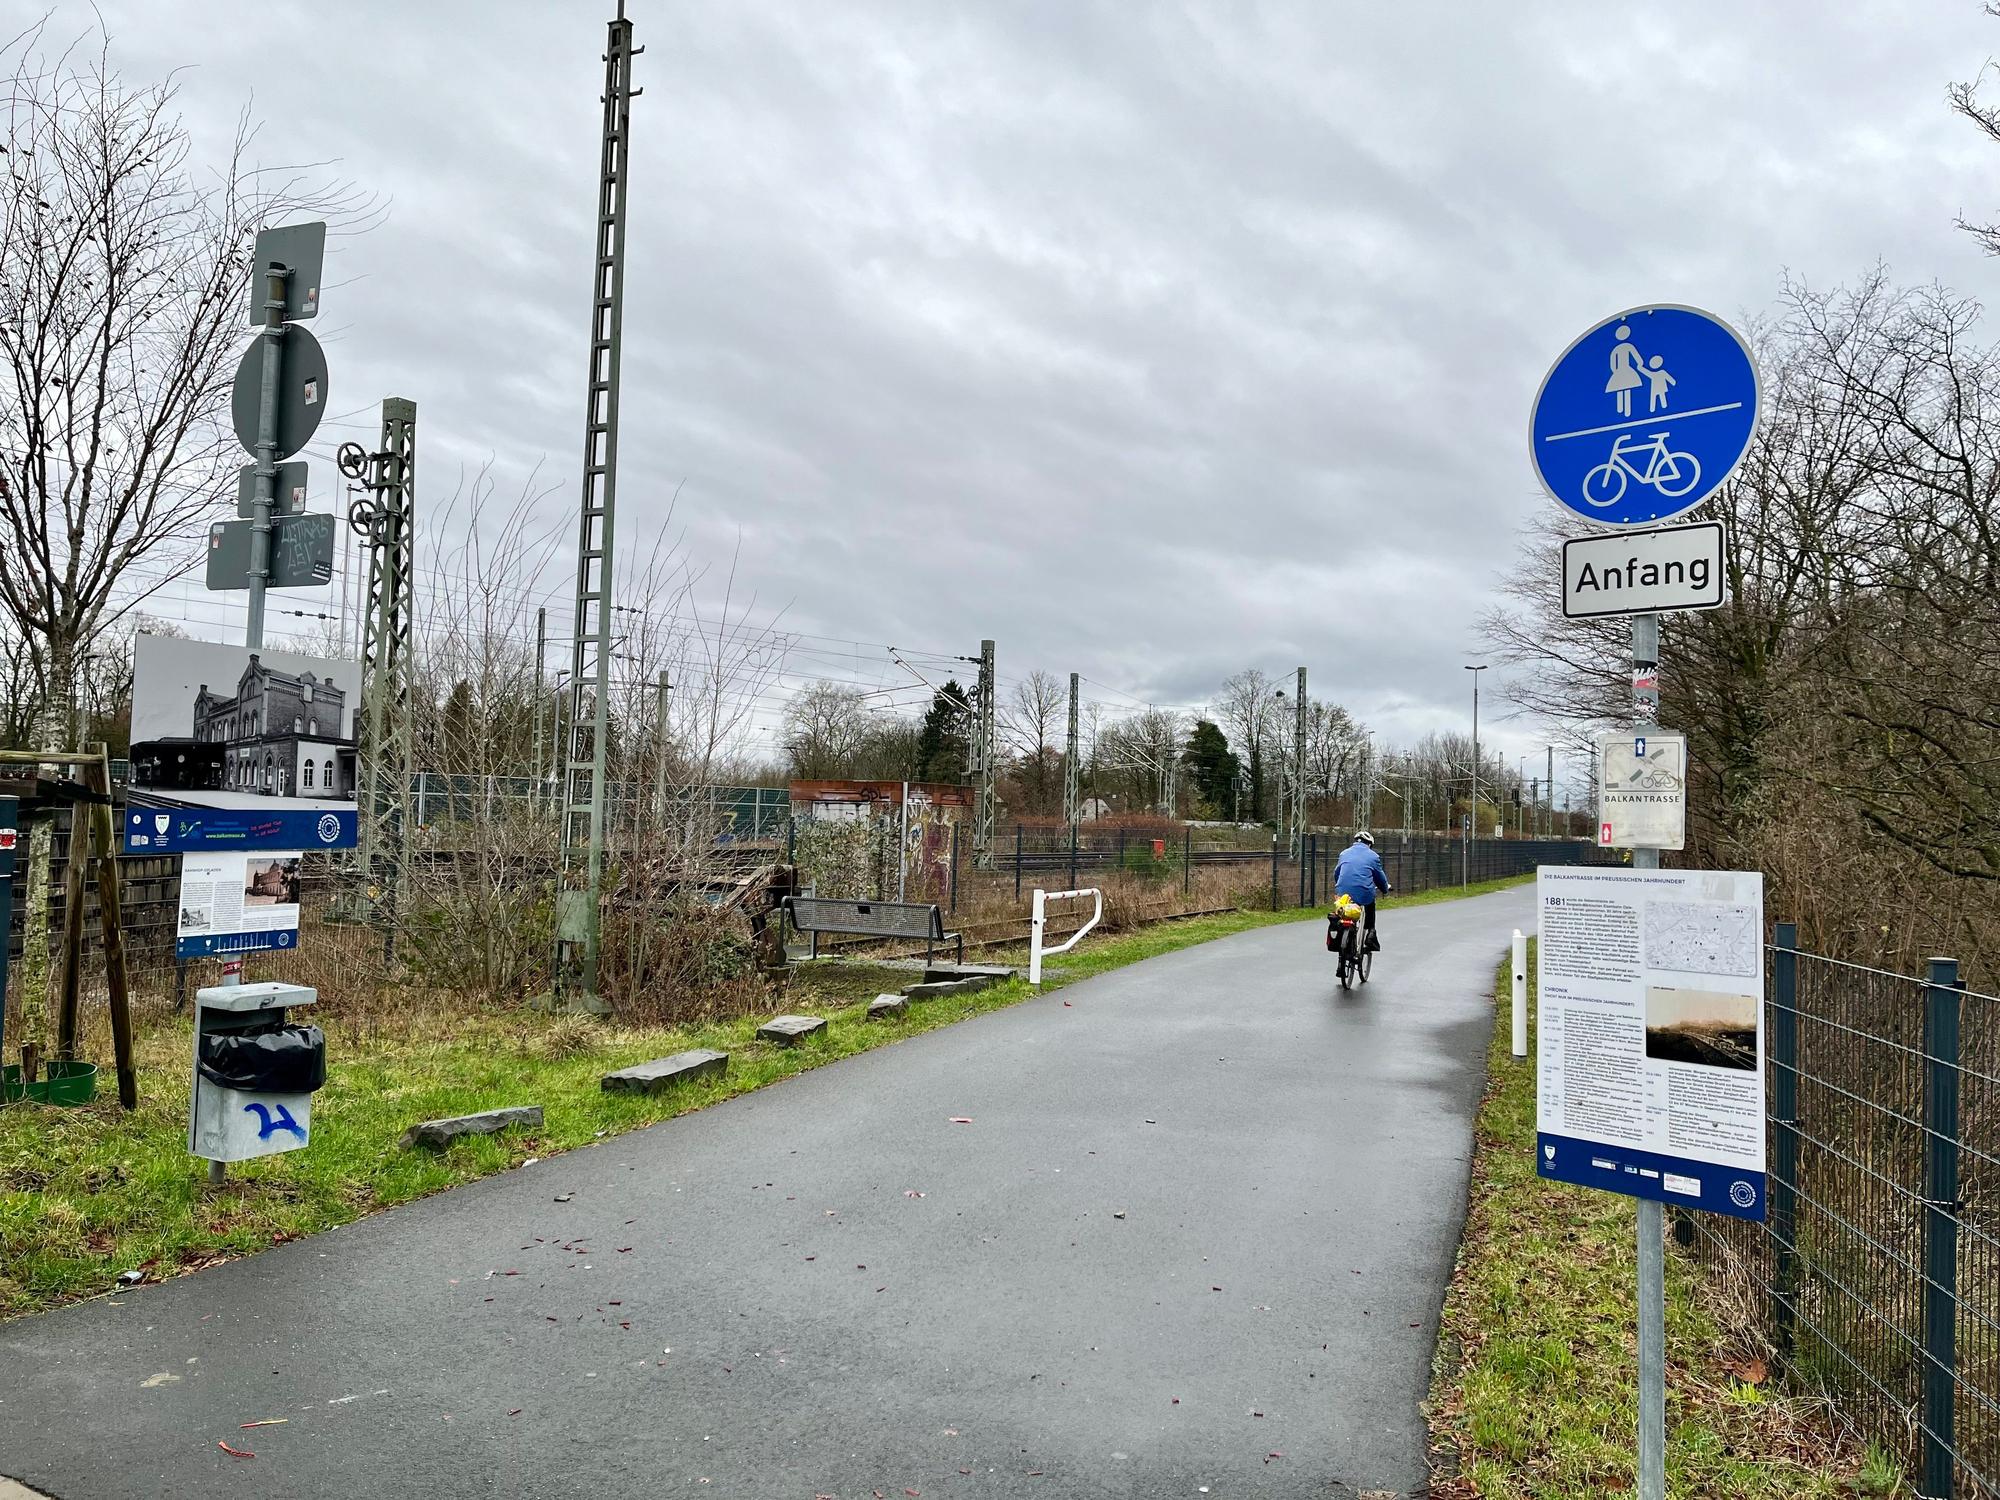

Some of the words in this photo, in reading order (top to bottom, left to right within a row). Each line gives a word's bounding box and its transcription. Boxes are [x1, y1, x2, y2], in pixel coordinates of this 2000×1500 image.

[1575, 557, 1710, 593] Anfang
[1604, 795, 1680, 803] BALKANTRASSE
[1544, 897, 1566, 906] 1881
